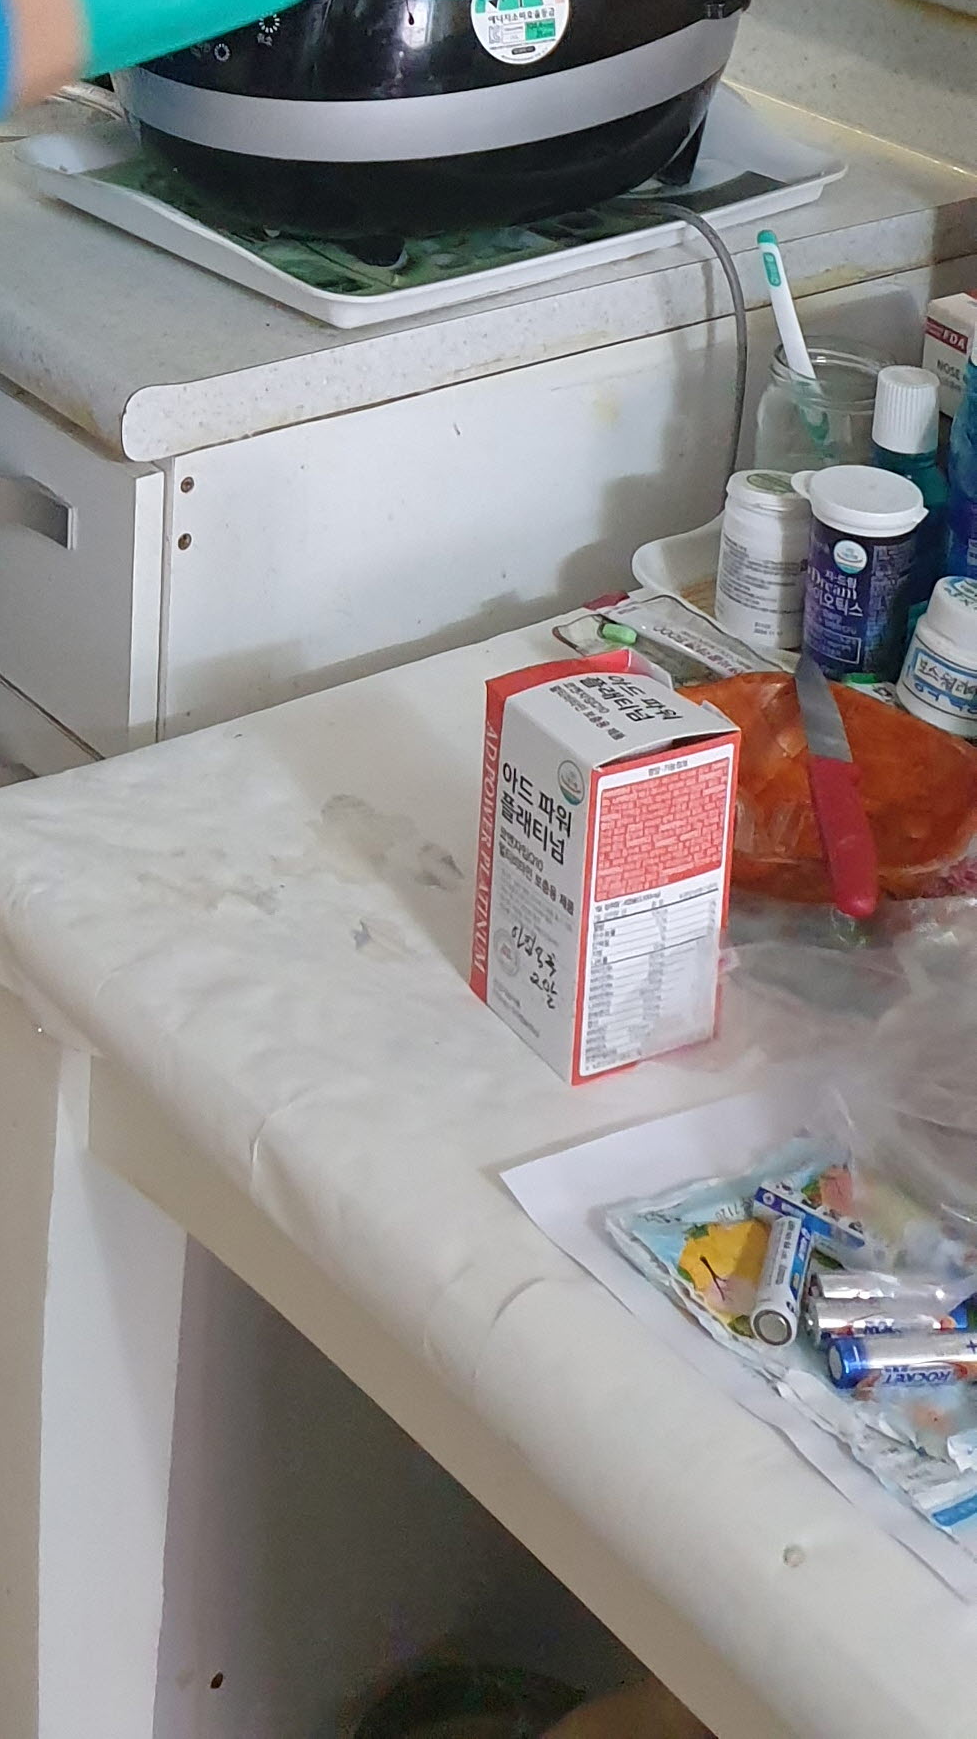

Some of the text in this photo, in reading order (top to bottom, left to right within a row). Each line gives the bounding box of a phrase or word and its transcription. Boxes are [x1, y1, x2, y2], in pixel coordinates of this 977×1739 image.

[942, 328, 966, 351] FDA
[936, 359, 961, 381] NOSE
[579, 675, 655, 722] 플래티넘
[608, 674, 683, 721] 아드 파워
[502, 762, 572, 838] 아드 파워
[473, 721, 499, 973] AD POWER PLATINUM
[500, 790, 565, 865] 플래티넘
[884, 1368, 952, 1384] ROCKET
